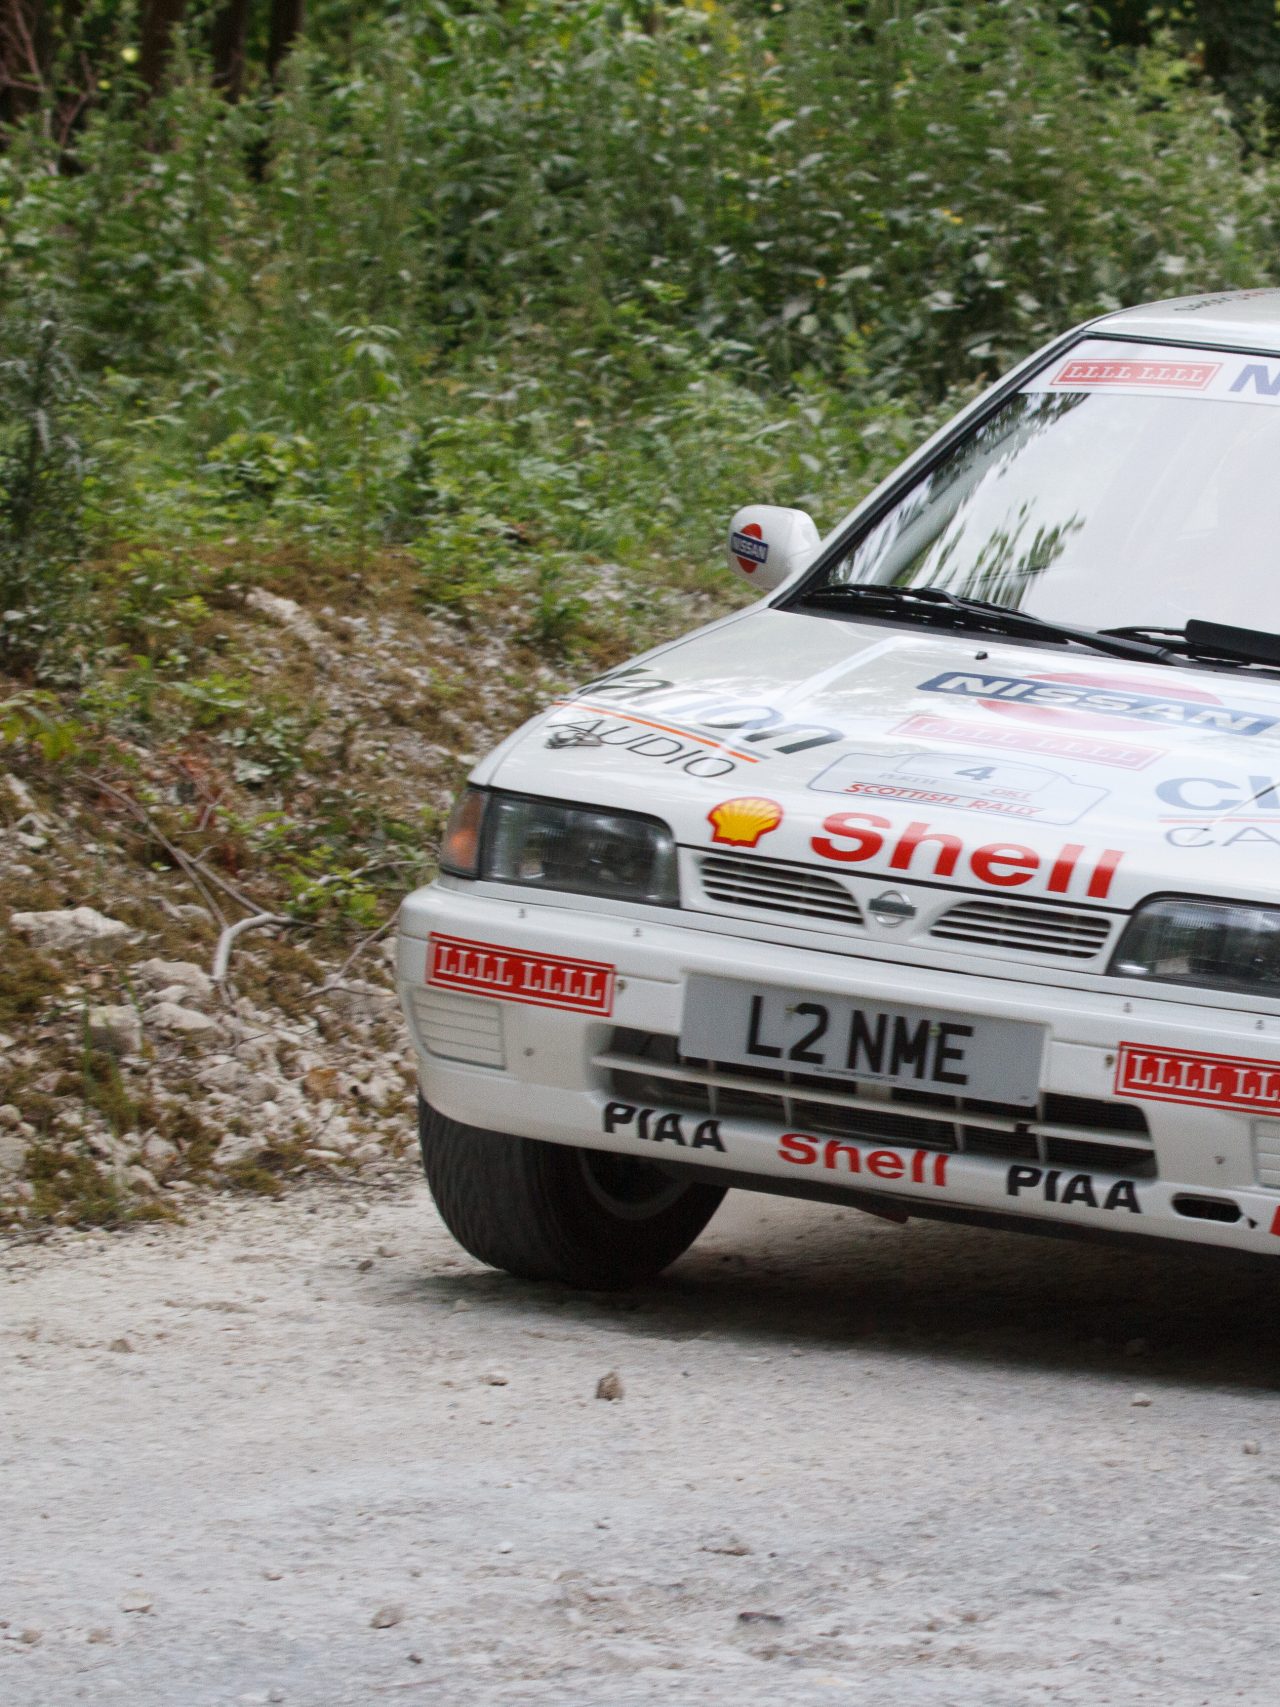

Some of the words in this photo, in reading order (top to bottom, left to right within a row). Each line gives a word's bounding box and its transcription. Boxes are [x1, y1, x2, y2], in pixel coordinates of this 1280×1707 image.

[936, 674, 1260, 731] NISSAN
[546, 719, 736, 778] AUDIO
[953, 765, 997, 781] 4
[845, 783, 960, 804] SCOTTISH
[967, 800, 1046, 816] RALLY
[809, 811, 1126, 899] Shell
[435, 945, 513, 986] LLLL
[520, 961, 602, 1001] LLLL
[745, 995, 829, 1065] L2
[847, 1009, 975, 1086] NME
[1129, 1054, 1222, 1094] LLLL
[603, 1101, 728, 1153] PIAA
[777, 1132, 949, 1187] Shell
[1006, 1164, 1142, 1214] PIAA
